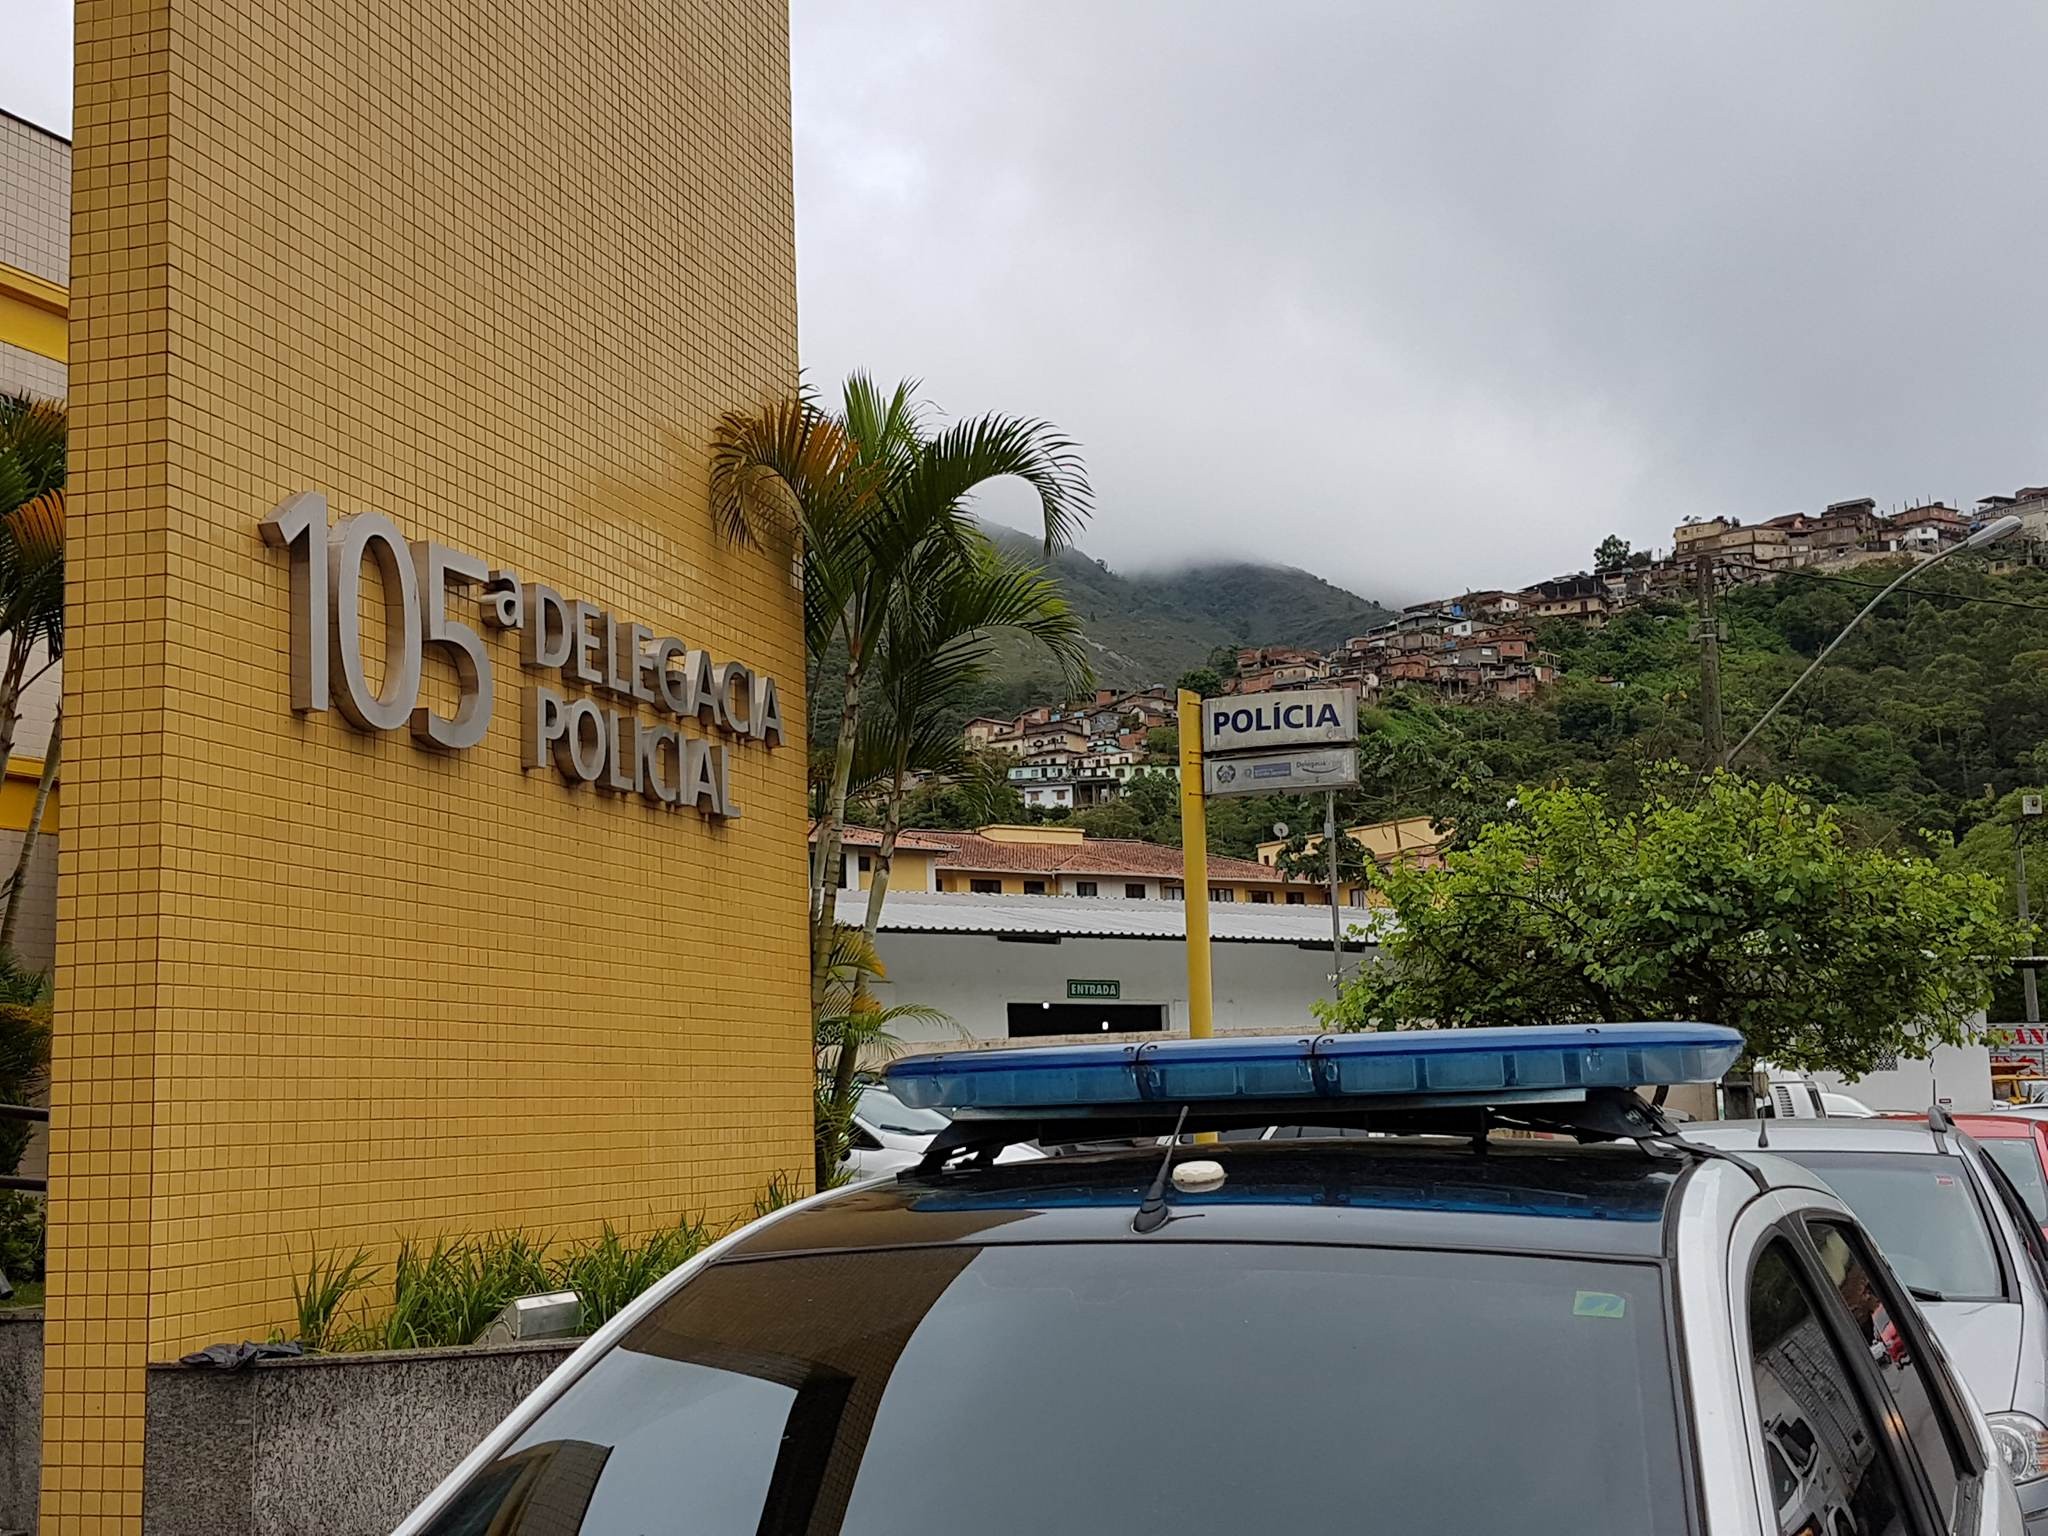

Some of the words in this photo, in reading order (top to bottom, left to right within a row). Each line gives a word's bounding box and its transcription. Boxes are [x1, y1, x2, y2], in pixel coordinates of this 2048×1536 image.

[520, 582, 786, 748] DELEGACIA
[520, 686, 742, 820] POLICIAL
[1213, 702, 1341, 736] POLÍCIA
[1071, 984, 1116, 995] ENTRADA
